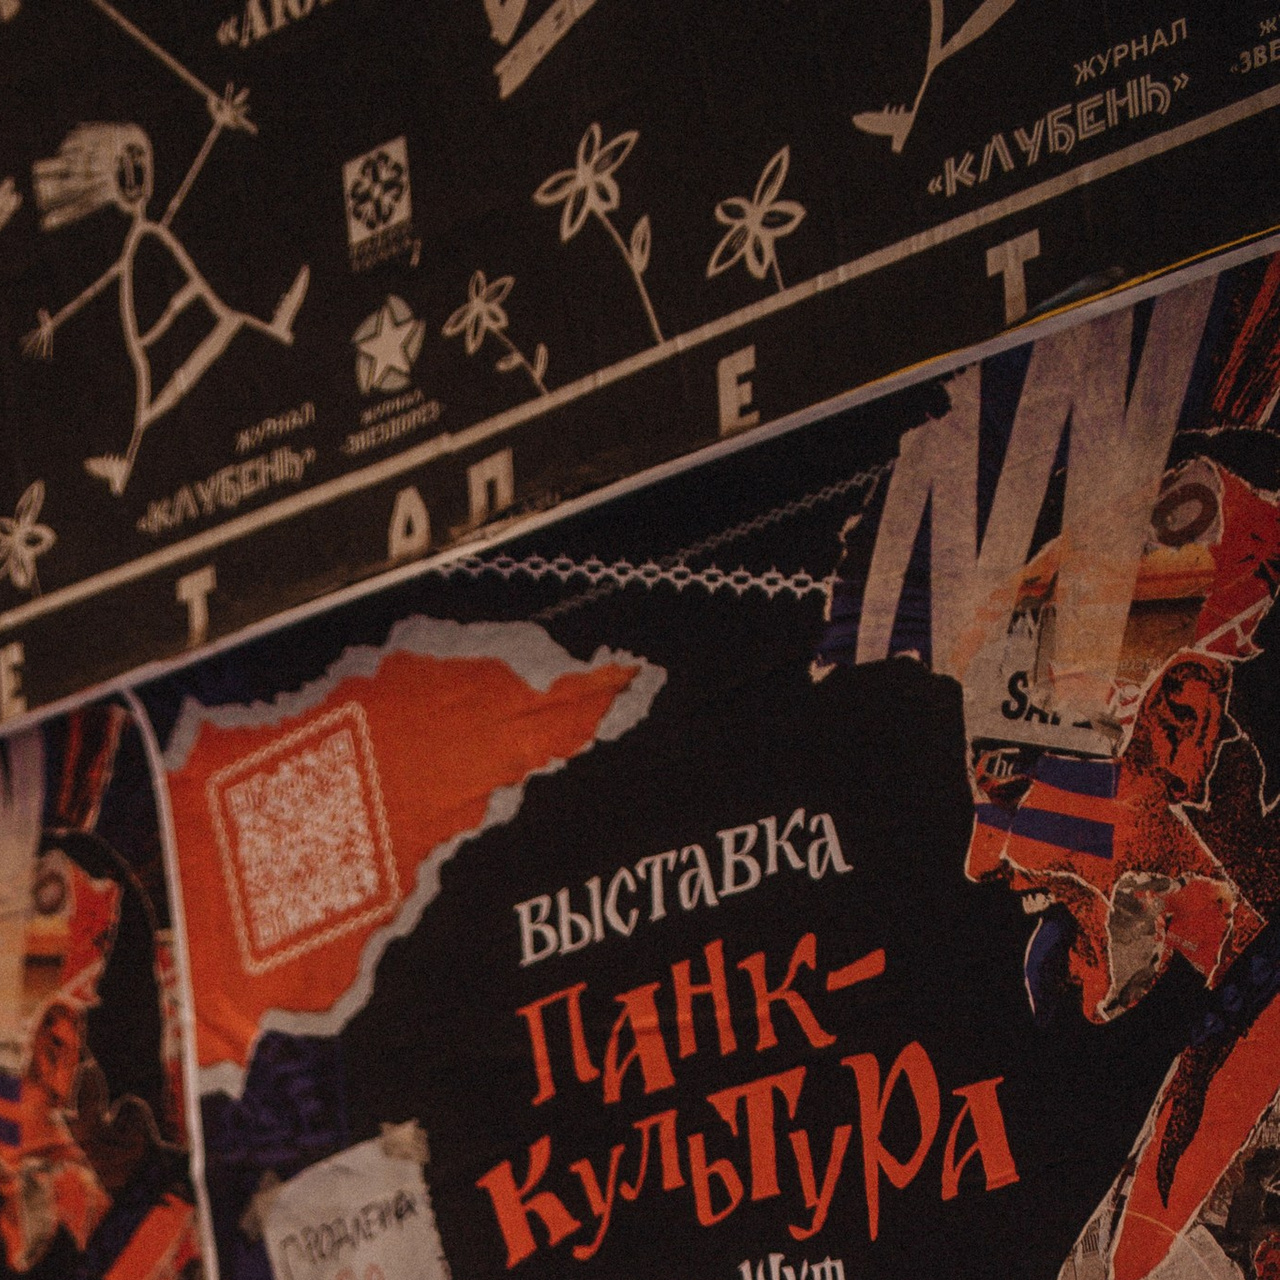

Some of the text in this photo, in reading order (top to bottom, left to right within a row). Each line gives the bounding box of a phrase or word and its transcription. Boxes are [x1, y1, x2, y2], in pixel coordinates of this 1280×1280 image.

[1074, 17, 1189, 87] ЖУРНАЛ
[235, 401, 316, 454] ЖУРНАЛ
[514, 807, 854, 968] ВЫСТАВКА
[515, 931, 887, 1106] ПАНК-
[476, 1040, 1021, 1269] КУЛЬТУРА
